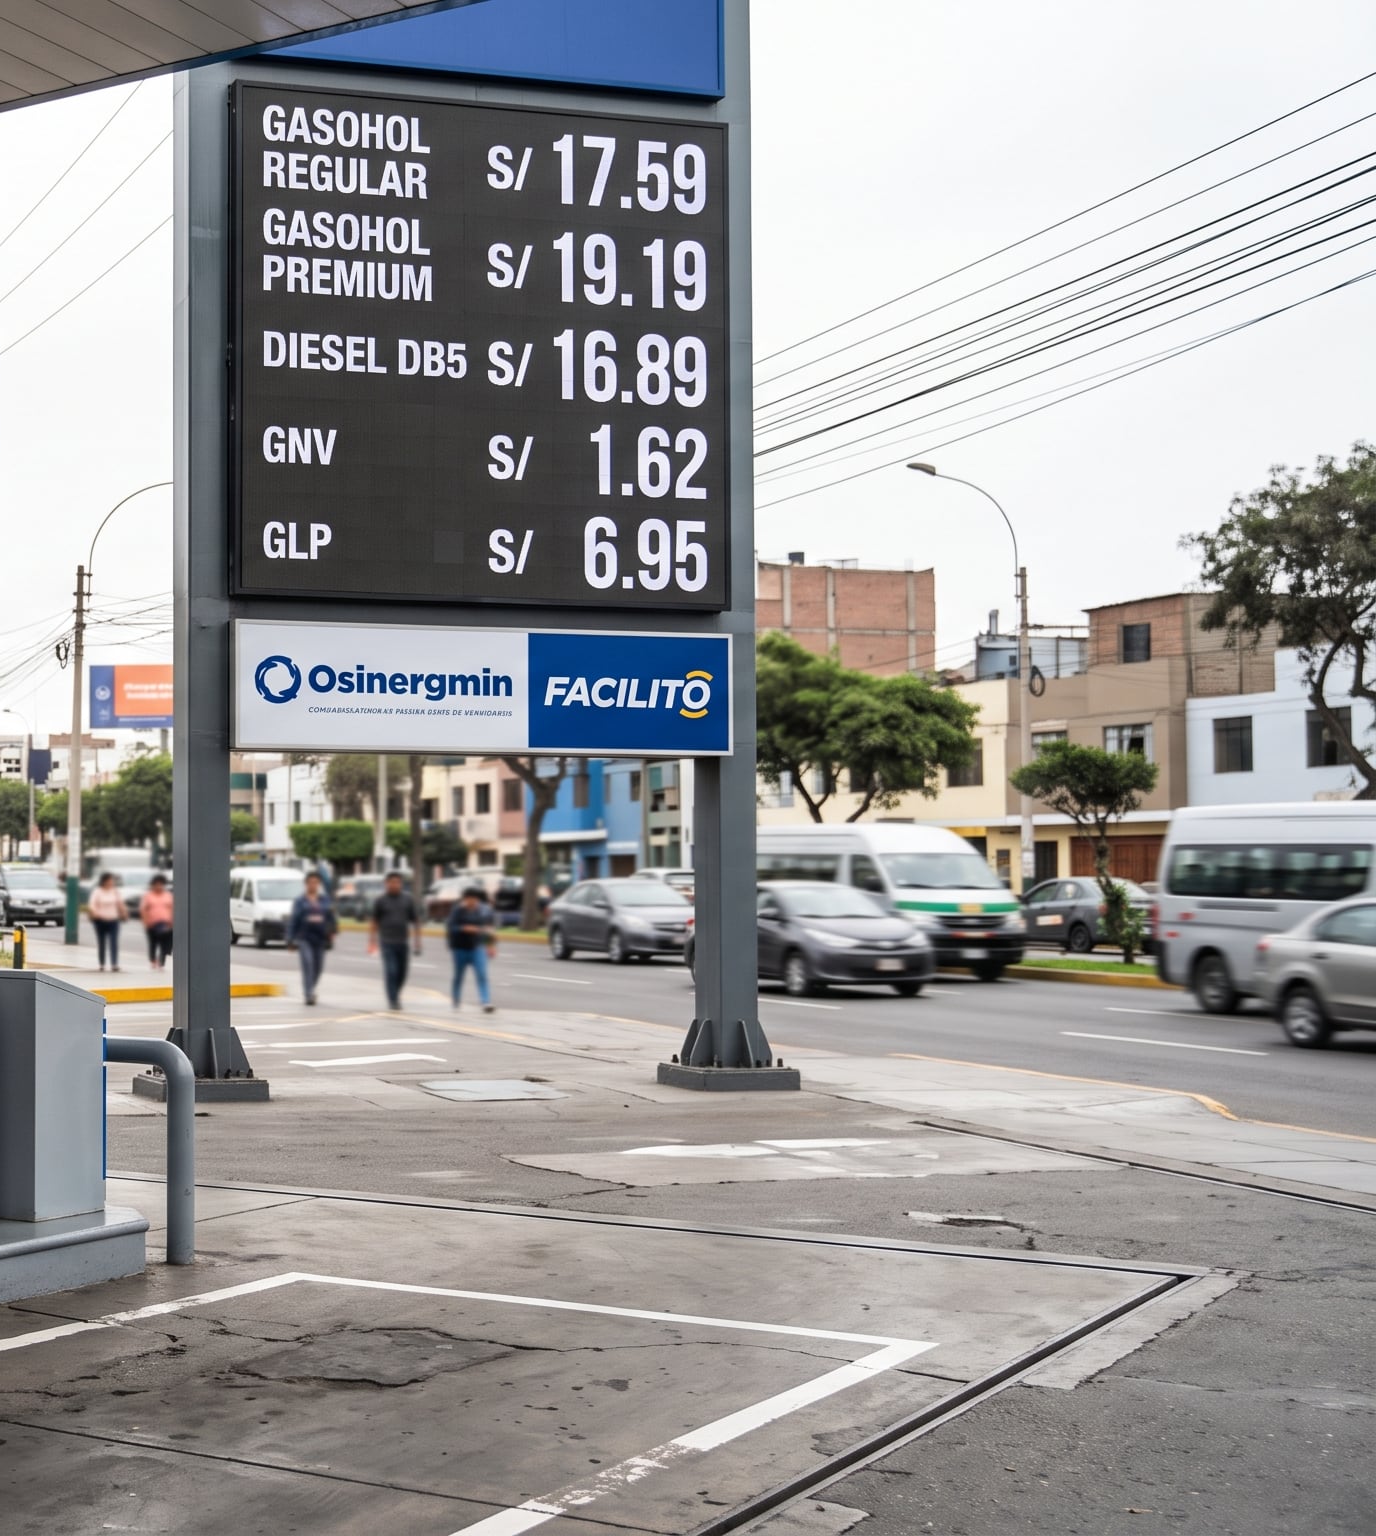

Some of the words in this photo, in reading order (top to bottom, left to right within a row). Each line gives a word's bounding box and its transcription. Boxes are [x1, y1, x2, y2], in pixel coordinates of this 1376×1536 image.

[262, 104, 431, 154] GASOHOL
[262, 150, 428, 200] REGULAR
[486, 145, 533, 191] S/
[552, 133, 707, 215] 17.59
[262, 207, 431, 256] GASOHOL
[262, 254, 433, 302] PREMIUM
[486, 242, 534, 289] S/
[552, 231, 707, 312] 19.19
[262, 330, 388, 374] DIESEL
[398, 338, 467, 379] DB5
[487, 340, 534, 387] S/
[553, 328, 707, 408] 16.89
[262, 425, 338, 466] GNV
[487, 434, 534, 481] S/
[590, 423, 708, 500] 1.62
[262, 521, 332, 560] GLP
[488, 528, 534, 575] S/
[584, 516, 708, 593] 6.95
[307, 664, 513, 702] Osinergmin
[544, 676, 711, 710] FACILITO
